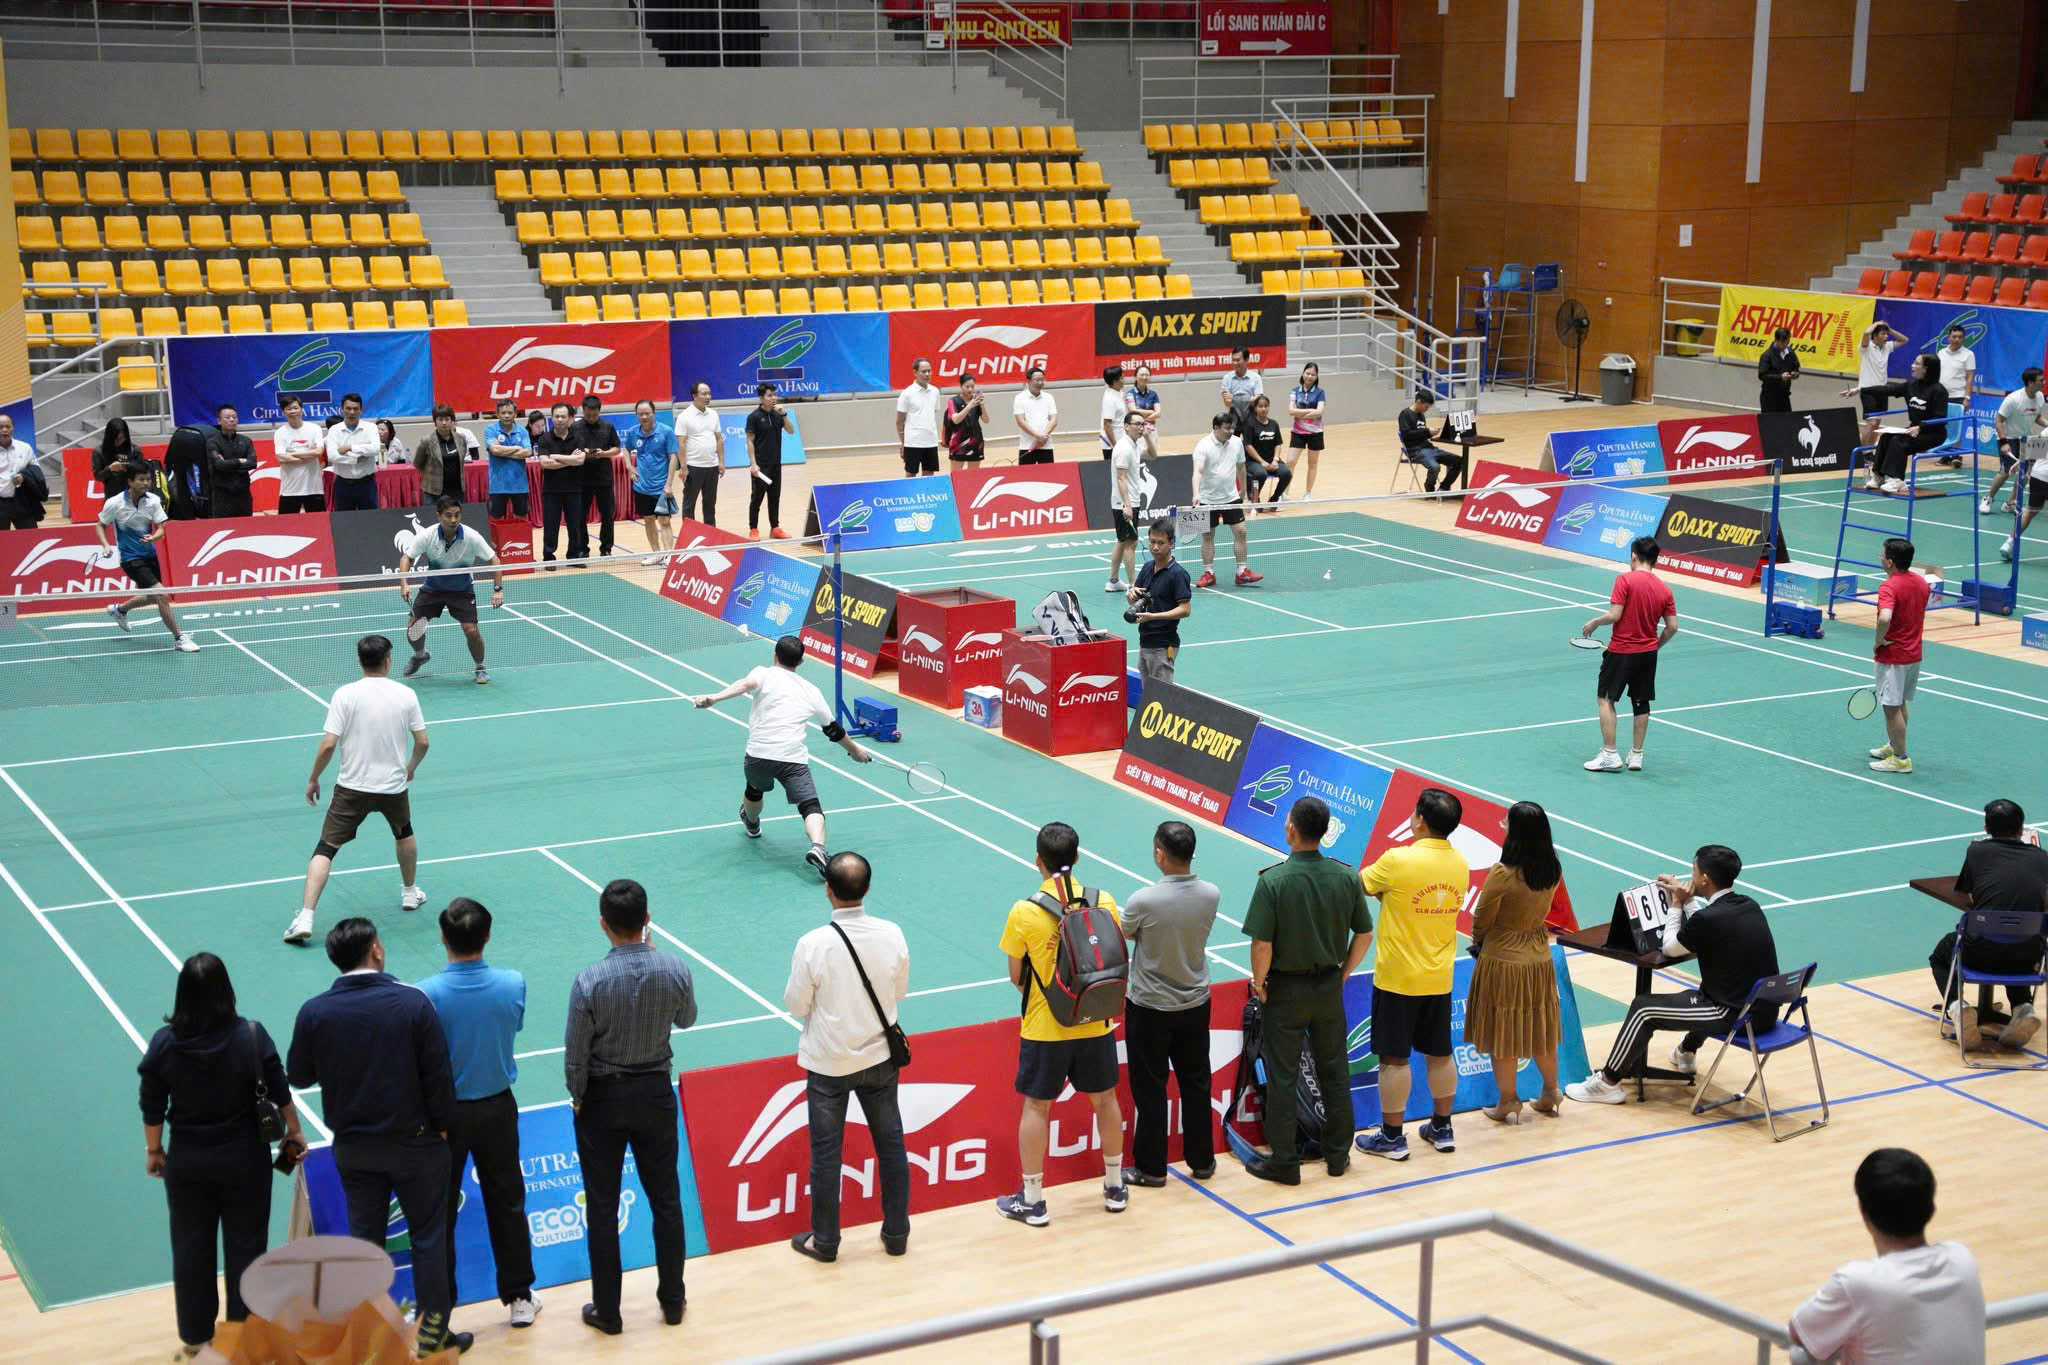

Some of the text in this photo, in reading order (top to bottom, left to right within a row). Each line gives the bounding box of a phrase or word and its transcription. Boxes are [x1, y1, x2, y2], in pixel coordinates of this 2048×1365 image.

[983, 20, 1060, 40] CANTEEN
[1228, 14, 1259, 31] SANG
[1262, 10, 1293, 31] KHÁN
[1318, 14, 1326, 31] C
[1118, 310, 1262, 346] MAXX SPORT
[1730, 304, 1833, 341] ASHAWAY
[1730, 336, 1767, 348] MADE
[1790, 343, 1816, 354] USA
[939, 353, 1048, 376] LI-NING
[1185, 355, 1215, 366] TRANG
[490, 375, 616, 399] LI-NING
[786, 381, 819, 392] HANOI
[1597, 440, 1656, 453] CIPUTRA HANOI
[1676, 455, 1755, 472] LI-NING
[1792, 453, 1837, 468] le coq sportif
[873, 492, 948, 507] CIPUTRA HANOI
[972, 506, 1073, 530] LI-NING
[1466, 505, 1544, 532] LI-NING
[1667, 510, 1761, 546] MAXX SPORT
[192, 563, 322, 588] LI-NING
[668, 570, 723, 605] LI-NING
[851, 600, 887, 628] SPORT
[902, 651, 944, 673] LI-NING
[954, 648, 1003, 663] LI-NIN
[971, 701, 983, 717] 3A
[1005, 690, 1048, 718] LI-NING
[1058, 691, 1119, 707] LI-NING
[1140, 701, 1242, 762] MAXX SPORT
[1166, 782, 1187, 800] TRANG
[1201, 797, 1219, 813] THAO
[1298, 769, 1374, 812] CIPUTRA HANOI
[1625, 889, 1669, 921] 0 6 8
[1460, 1063, 1492, 1074] CULTUR
[736, 1138, 987, 1222] LI-NNG
[530, 1207, 578, 1234] ECO
[534, 1229, 581, 1245] CULTURE
